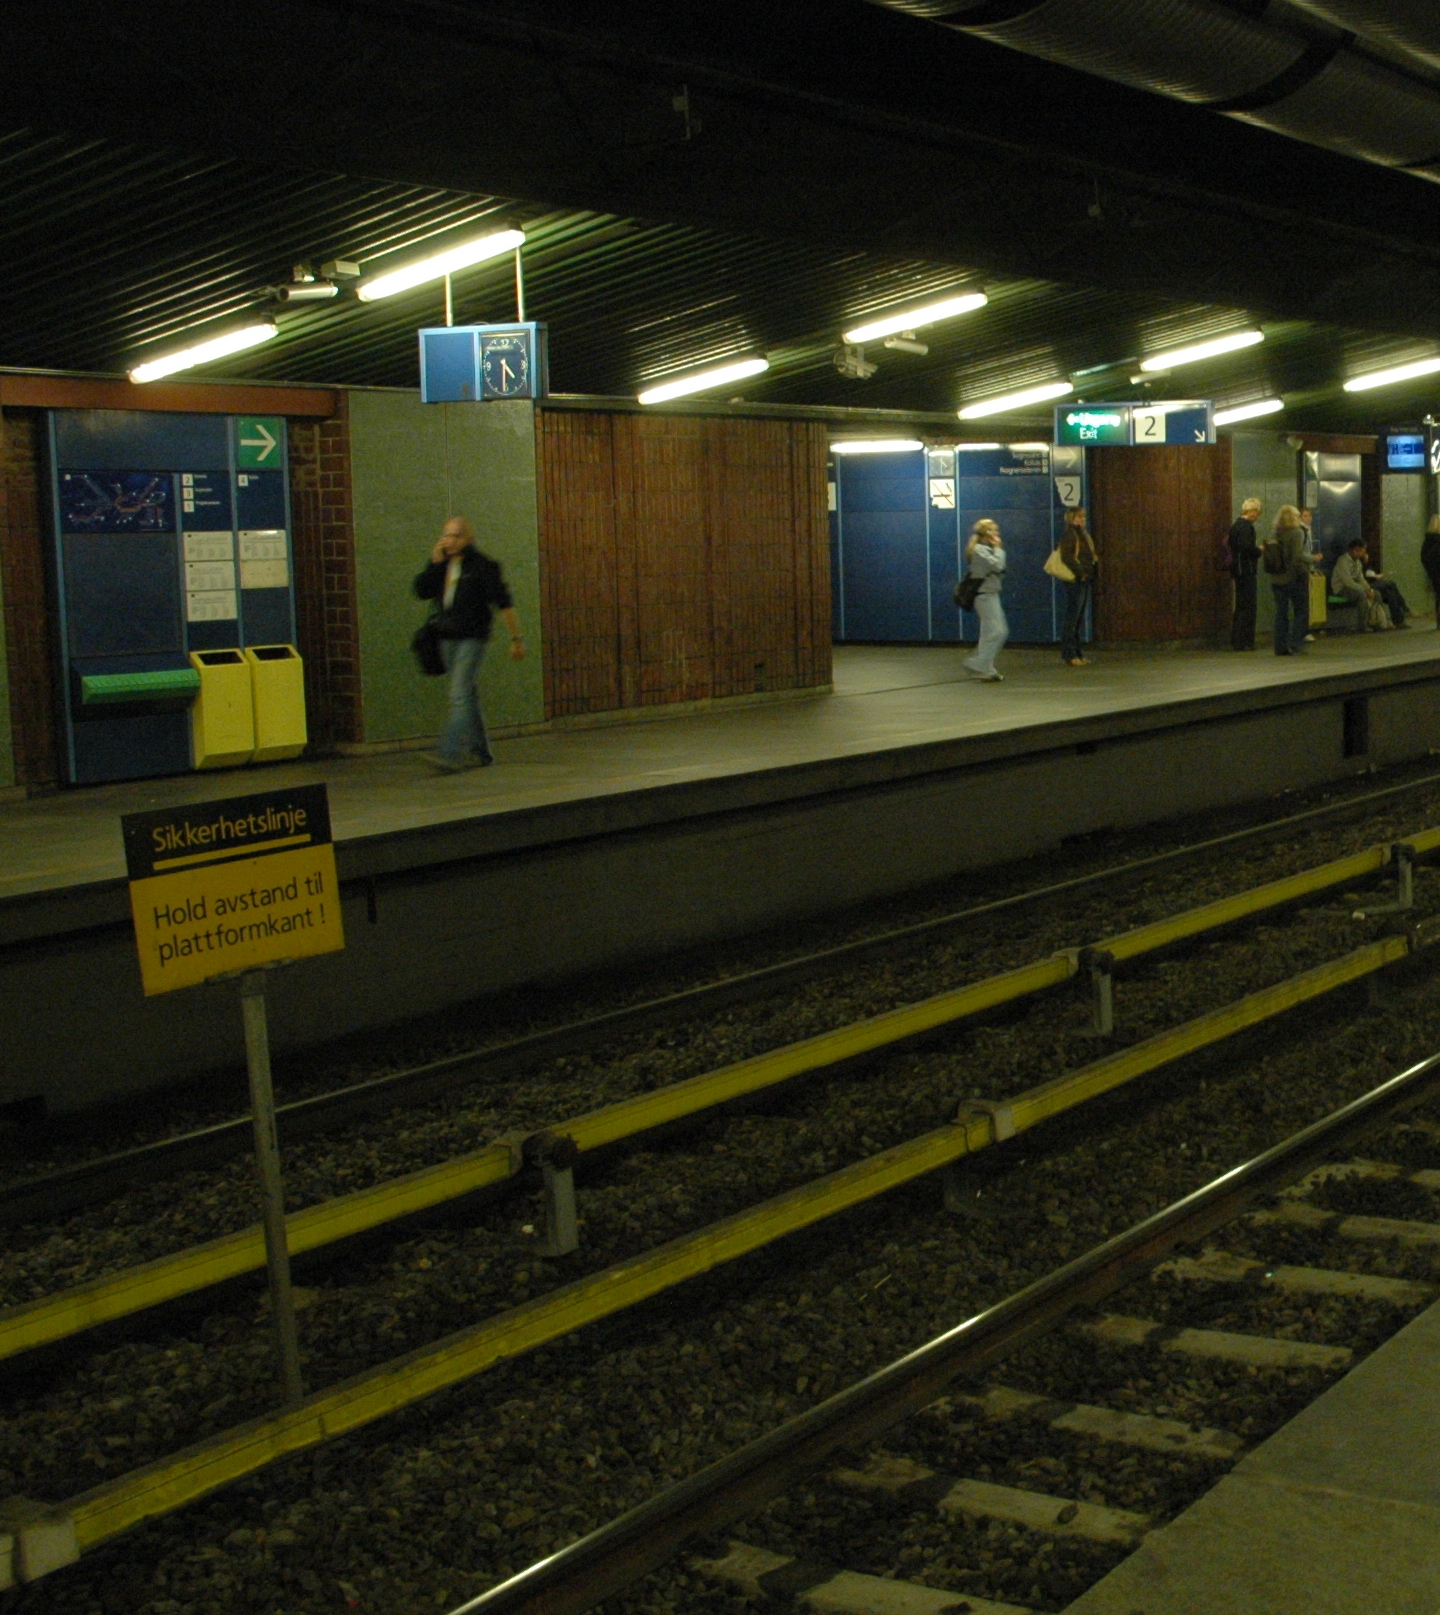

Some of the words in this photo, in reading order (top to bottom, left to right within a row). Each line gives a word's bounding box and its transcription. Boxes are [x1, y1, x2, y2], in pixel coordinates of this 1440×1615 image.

[486, 361, 492, 372] 9
[1144, 415, 1157, 436] 2
[1063, 483, 1075, 502] 2
[152, 807, 307, 852] Sikkerhetslinje
[153, 895, 208, 929] Hold
[214, 877, 299, 917] avstand
[304, 871, 324, 896] til
[158, 908, 314, 968] plattformkant
[319, 902, 326, 925] !
